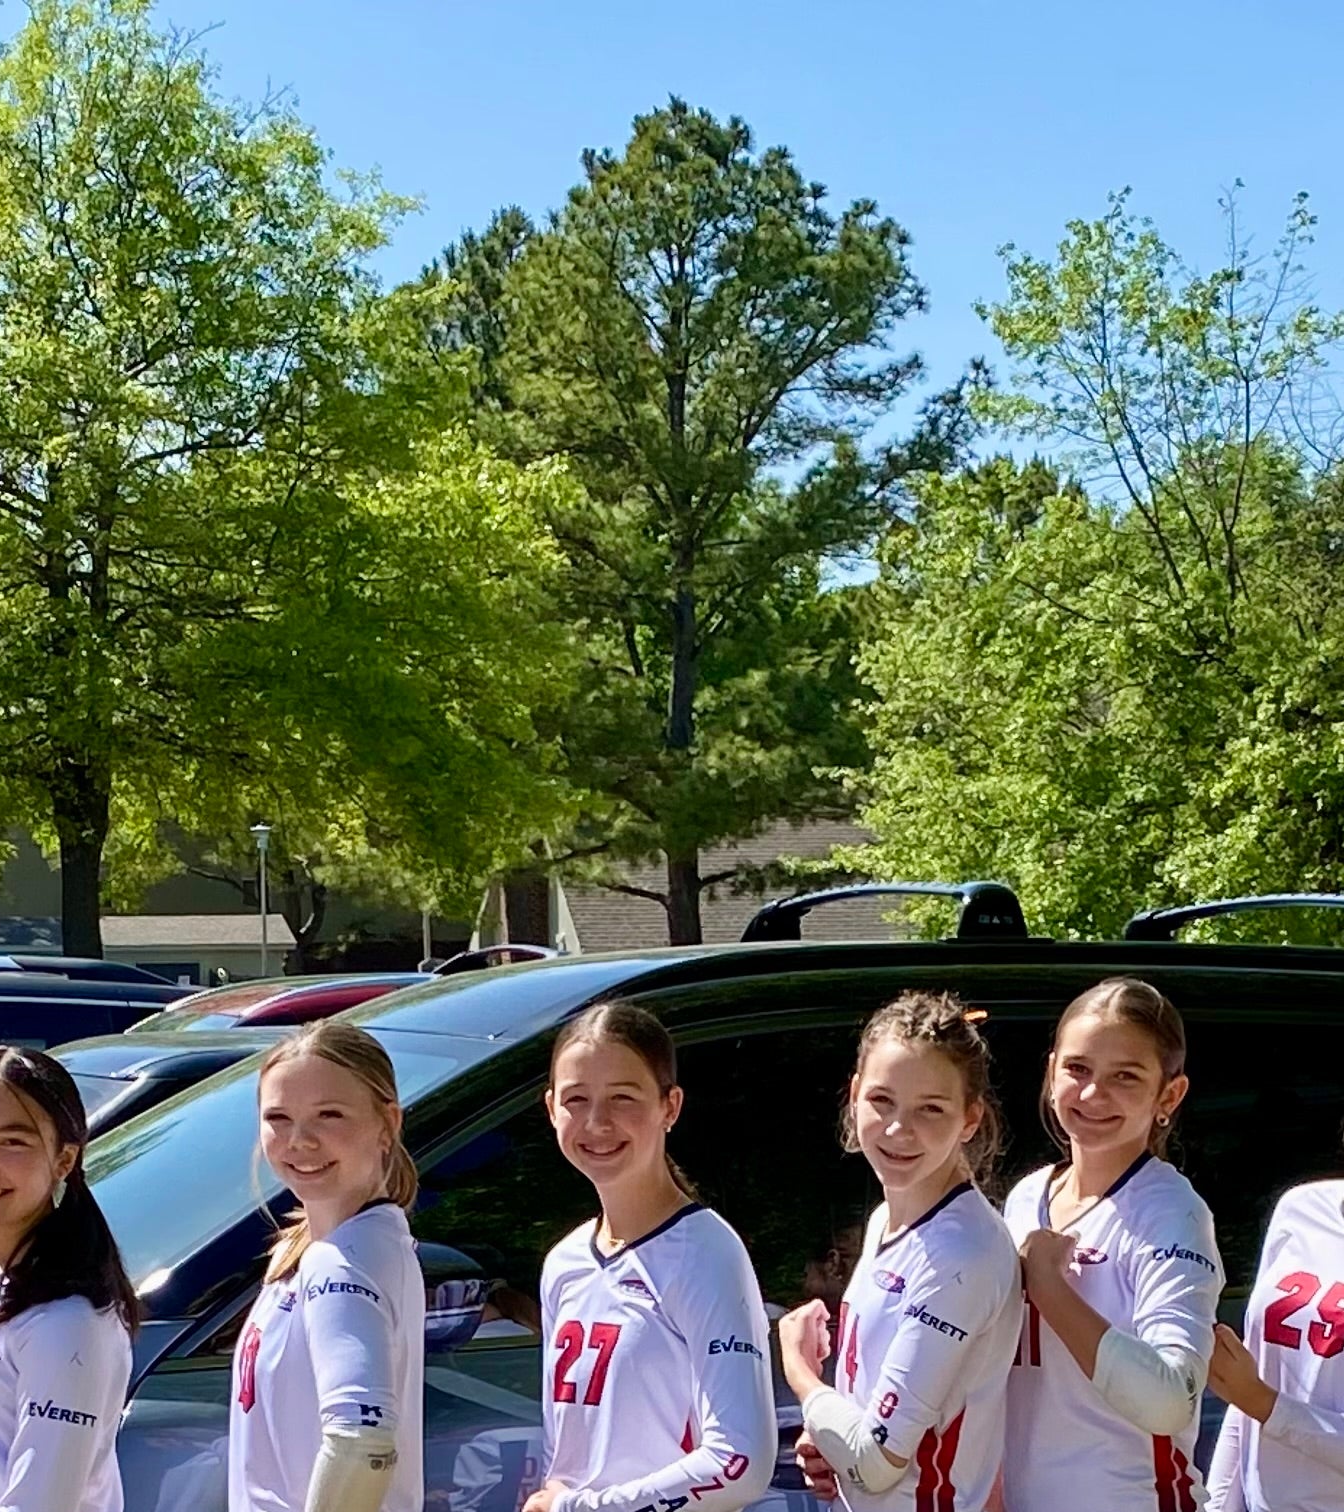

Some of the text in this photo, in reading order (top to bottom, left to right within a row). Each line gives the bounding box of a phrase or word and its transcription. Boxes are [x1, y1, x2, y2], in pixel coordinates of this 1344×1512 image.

[307, 1276, 381, 1305] EVERETT
[553, 1320, 623, 1406] 27
[29, 1399, 98, 1428] EVERETT
